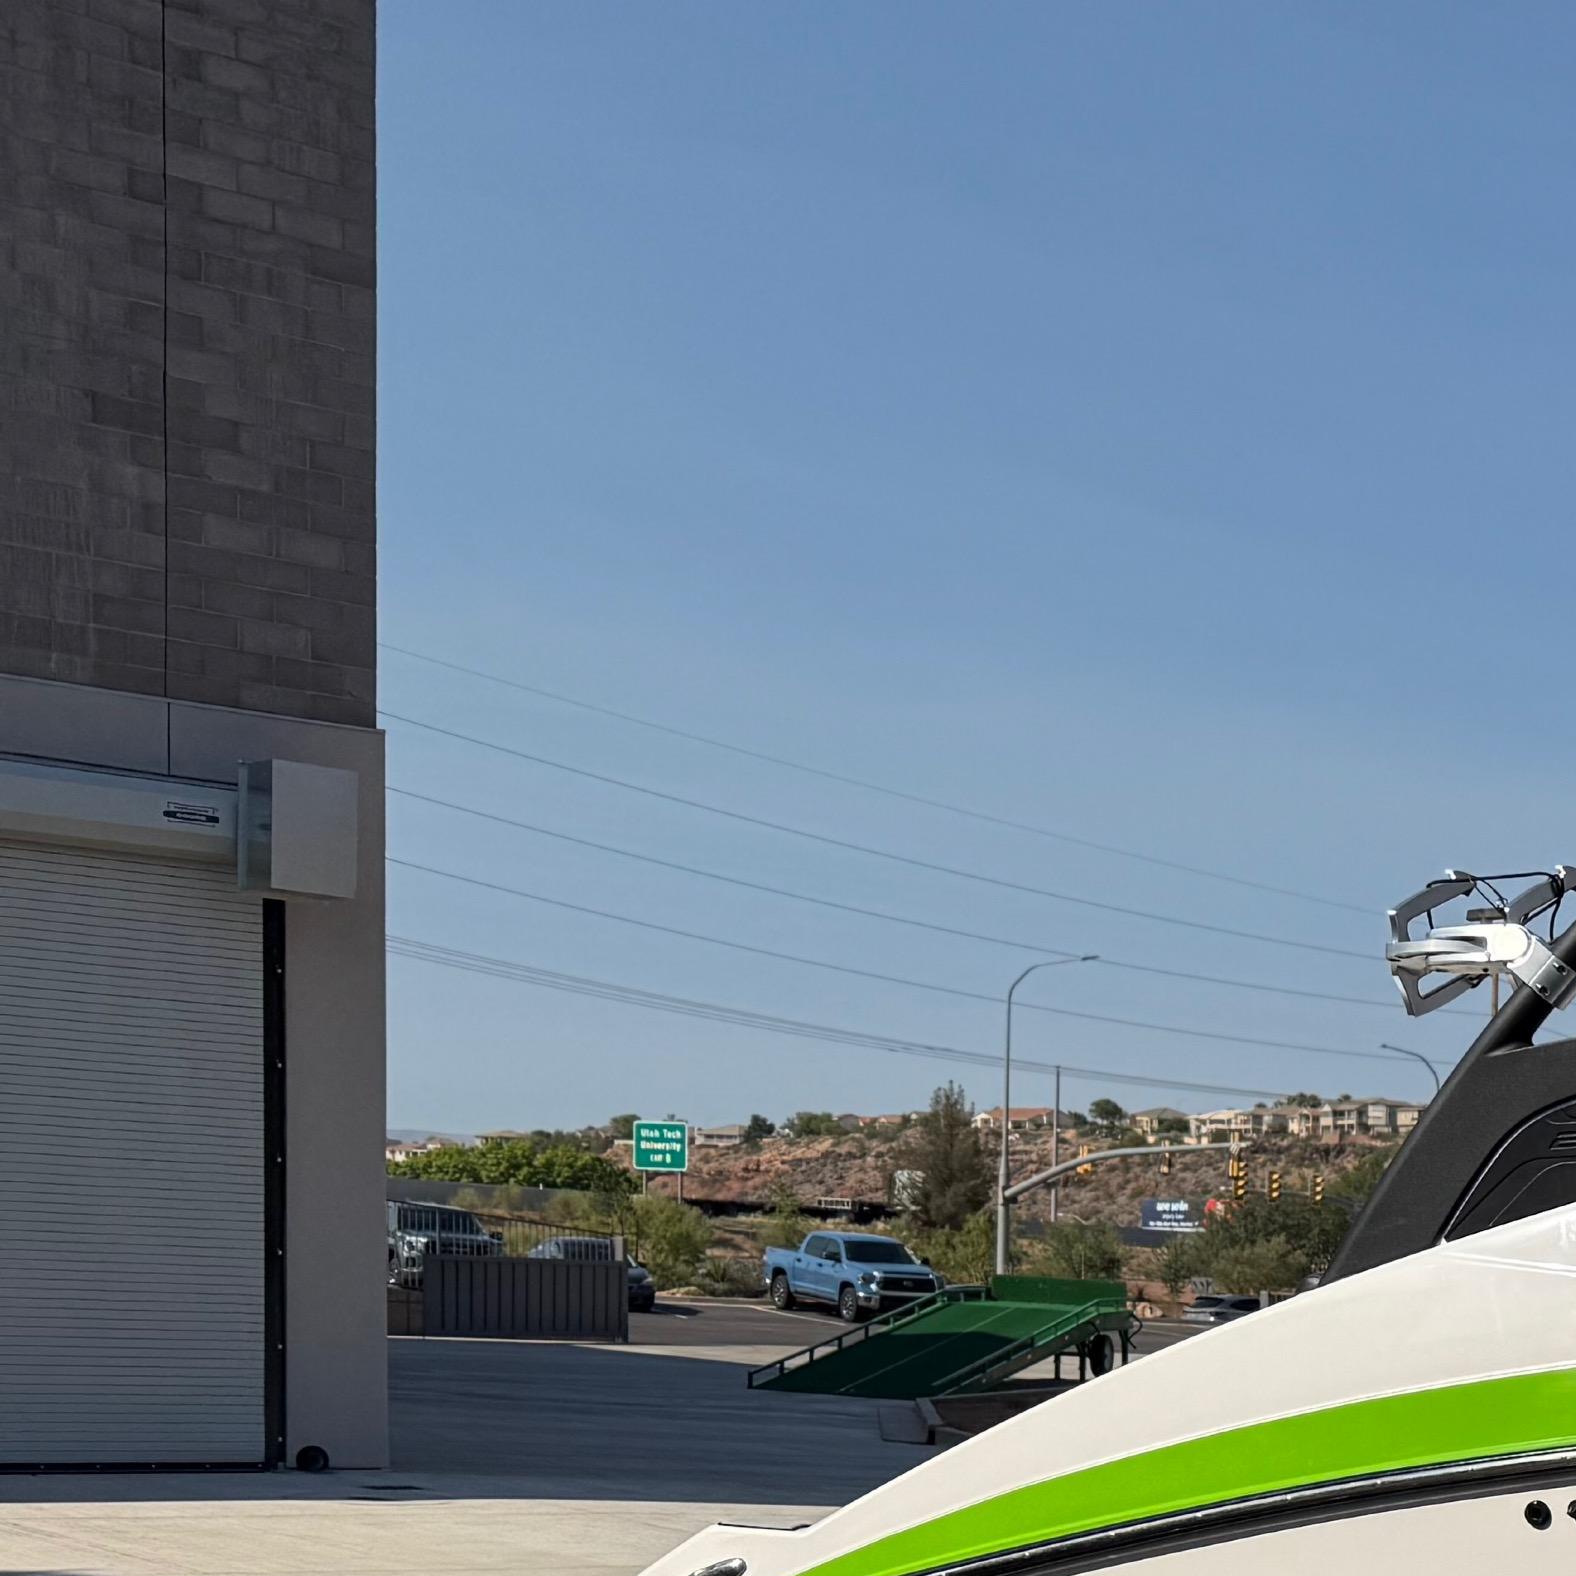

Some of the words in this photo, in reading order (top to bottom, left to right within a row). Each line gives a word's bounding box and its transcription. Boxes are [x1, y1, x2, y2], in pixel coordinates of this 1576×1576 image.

[640, 1128, 660, 1138] Utah
[662, 1128, 681, 1139] Tech
[640, 1140, 681, 1153] University
